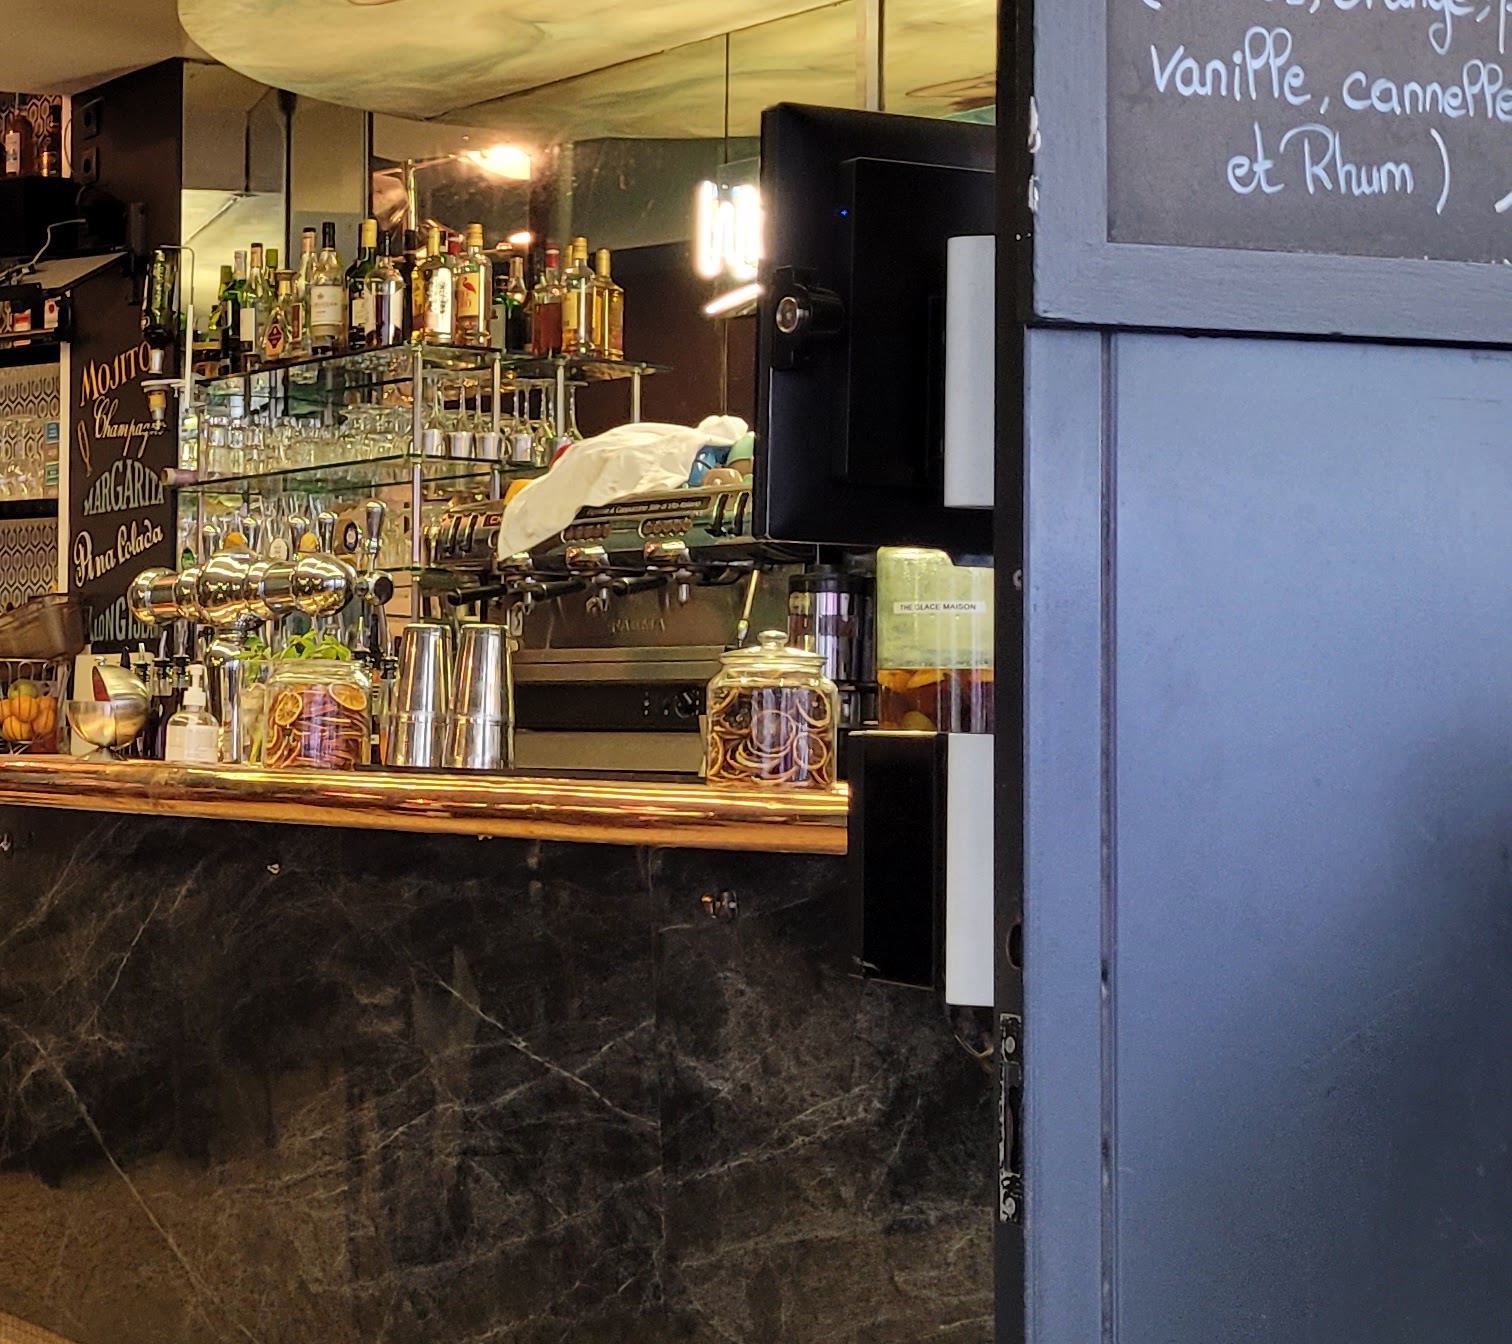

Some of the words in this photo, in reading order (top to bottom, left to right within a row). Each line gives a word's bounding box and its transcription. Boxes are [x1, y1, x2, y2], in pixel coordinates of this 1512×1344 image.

[1227, 121, 1285, 195] et
[93, 396, 167, 458] Champag
[83, 459, 165, 516] MARGARITA
[117, 519, 164, 564] Colada
